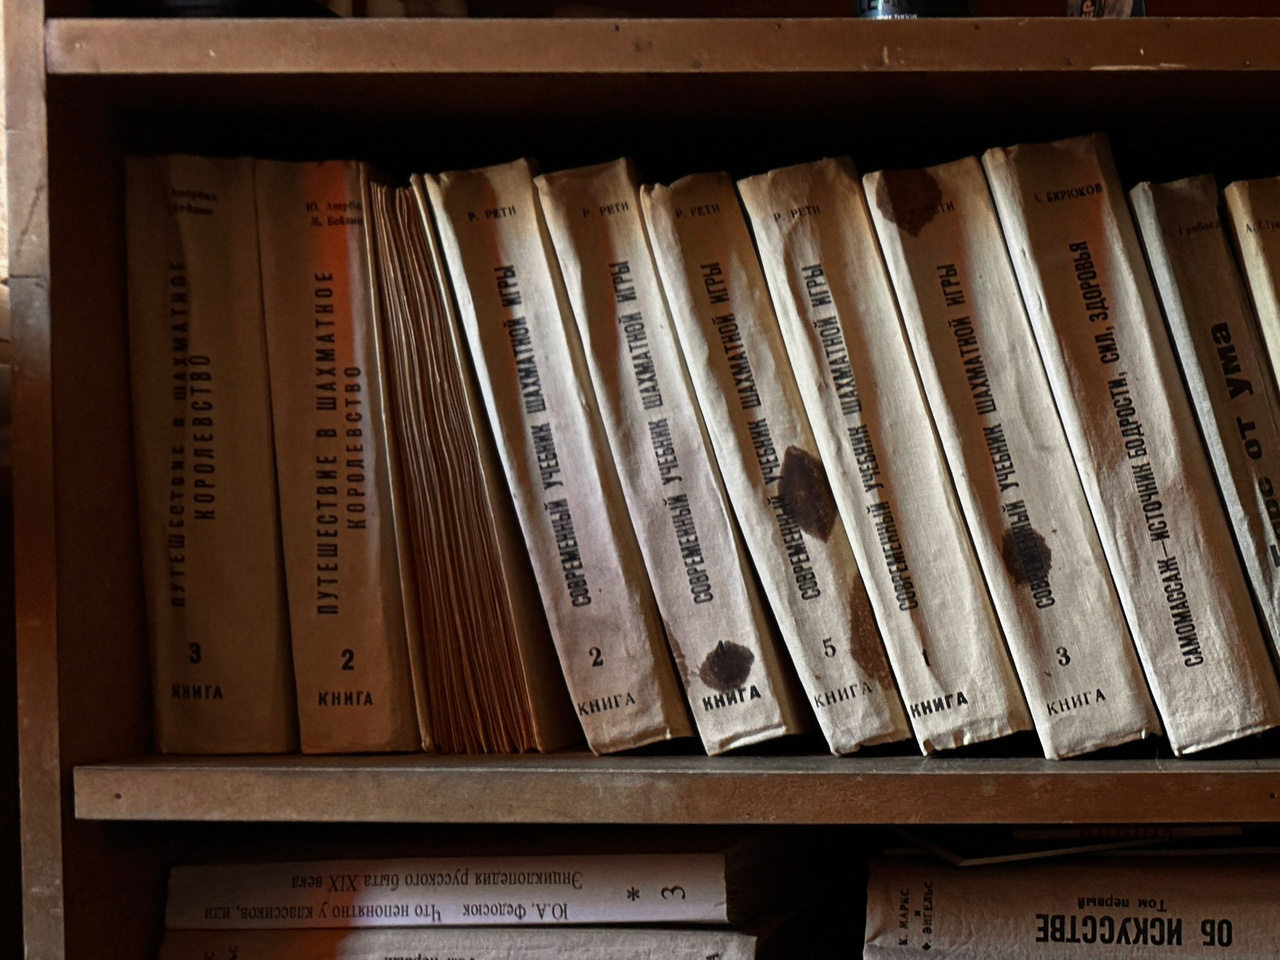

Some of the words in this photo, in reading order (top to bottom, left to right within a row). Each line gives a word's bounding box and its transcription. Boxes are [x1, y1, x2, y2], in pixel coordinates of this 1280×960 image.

[494, 264, 521, 308] ИГРЫ
[608, 260, 637, 304] ИГРЫ
[1068, 240, 1111, 324] ЗДОРОВЬЯ
[313, 271, 339, 412] ШАХМАТНОЕ
[1094, 325, 1121, 365] СИЛ,
[502, 315, 548, 415] ШАХМАТНОЙ
[617, 311, 664, 412] ШАХМАТНОЙ
[1210, 321, 1253, 400] ума
[1105, 371, 1148, 460] БОДРОСТИ,
[315, 426, 339, 439] В
[1236, 414, 1264, 460] от
[344, 366, 368, 530] КОРОЛЕВСТВО
[532, 422, 564, 491] УЧЕБНИК
[647, 417, 684, 487] УЧЕБНИК
[315, 454, 340, 615] ПУТЕШЕСТВИЕ
[543, 498, 593, 608] СОВРЕМЕННЫЙ
[662, 494, 714, 605] СОВРЕМЕННЫЙ
[189, 642, 202, 664] 3
[341, 649, 355, 671] 2
[588, 646, 604, 668] 2
[822, 637, 838, 659] 5
[1057, 646, 1072, 668] 3
[317, 690, 374, 706] КНИГА
[577, 691, 637, 717] КНИГА
[702, 684, 762, 712] КНИГА
[911, 690, 969, 719] КНИГА
[1047, 687, 1107, 716] КНИГА
[291, 875, 323, 889] века
[327, 874, 357, 893] XIX
[363, 873, 399, 892] быта
[404, 869, 470, 888] русского
[475, 871, 584, 890] Энциклопедия
[660, 884, 686, 901] 3
[1077, 894, 1130, 910] первый
[203, 905, 231, 920] или
[235, 904, 314, 921] классиков,
[318, 900, 329, 919] у
[331, 905, 411, 921] непонятно
[414, 903, 442, 923] Что
[462, 902, 527, 922] Федосюк
[532, 903, 569, 921] Ю.А.
[1137, 898, 1168, 912] Том
[1035, 913, 1183, 947] ИСКУССТВЕ
[1200, 918, 1234, 947] ОБ
